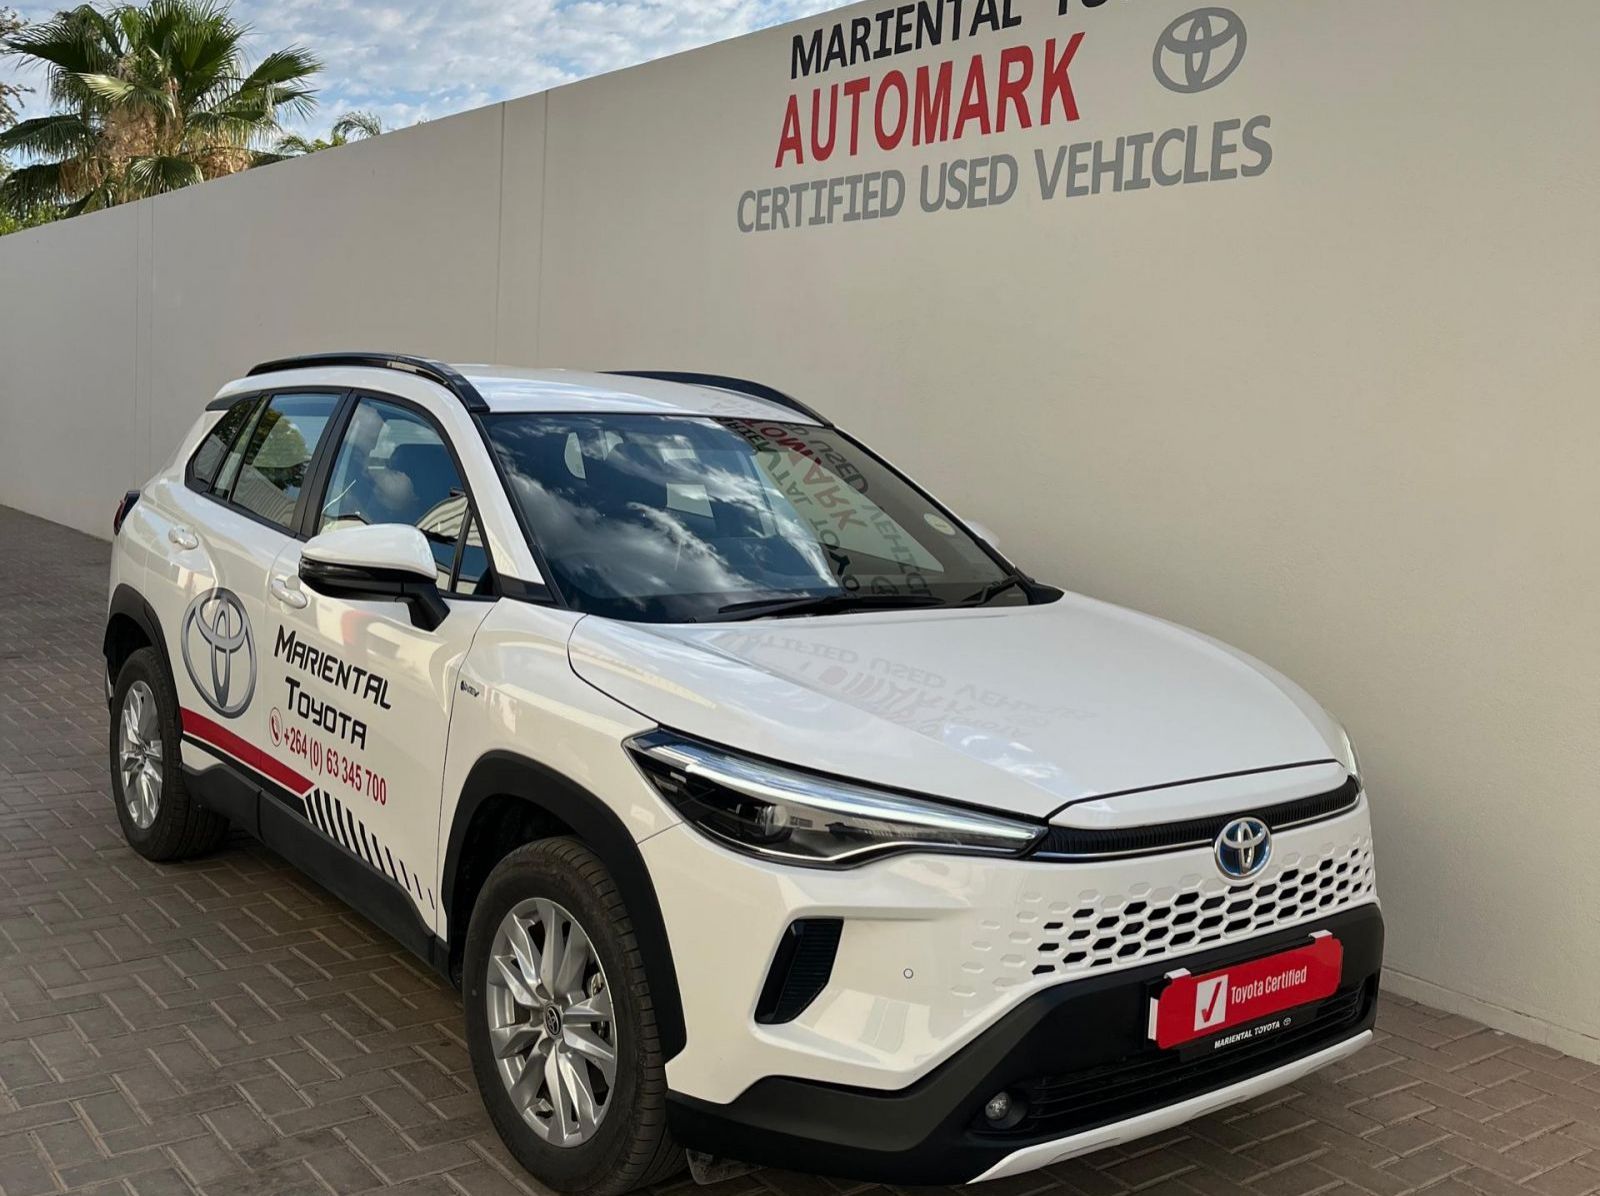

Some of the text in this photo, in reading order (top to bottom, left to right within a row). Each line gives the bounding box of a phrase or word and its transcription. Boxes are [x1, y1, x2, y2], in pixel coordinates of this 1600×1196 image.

[791, 0, 1022, 80] MARIENTAL
[774, 32, 1085, 168] AUTOMARK
[737, 115, 1272, 233] CERTIFIED USED VEHICLES
[274, 624, 391, 709] MARIENTAL
[285, 677, 367, 750] TOYOTA
[284, 727, 386, 805] +264 (0) 63 345 700
[1231, 965, 1308, 1005] Toyota Certified
[1214, 1020, 1280, 1049] MARIENTAL TOYOTA
